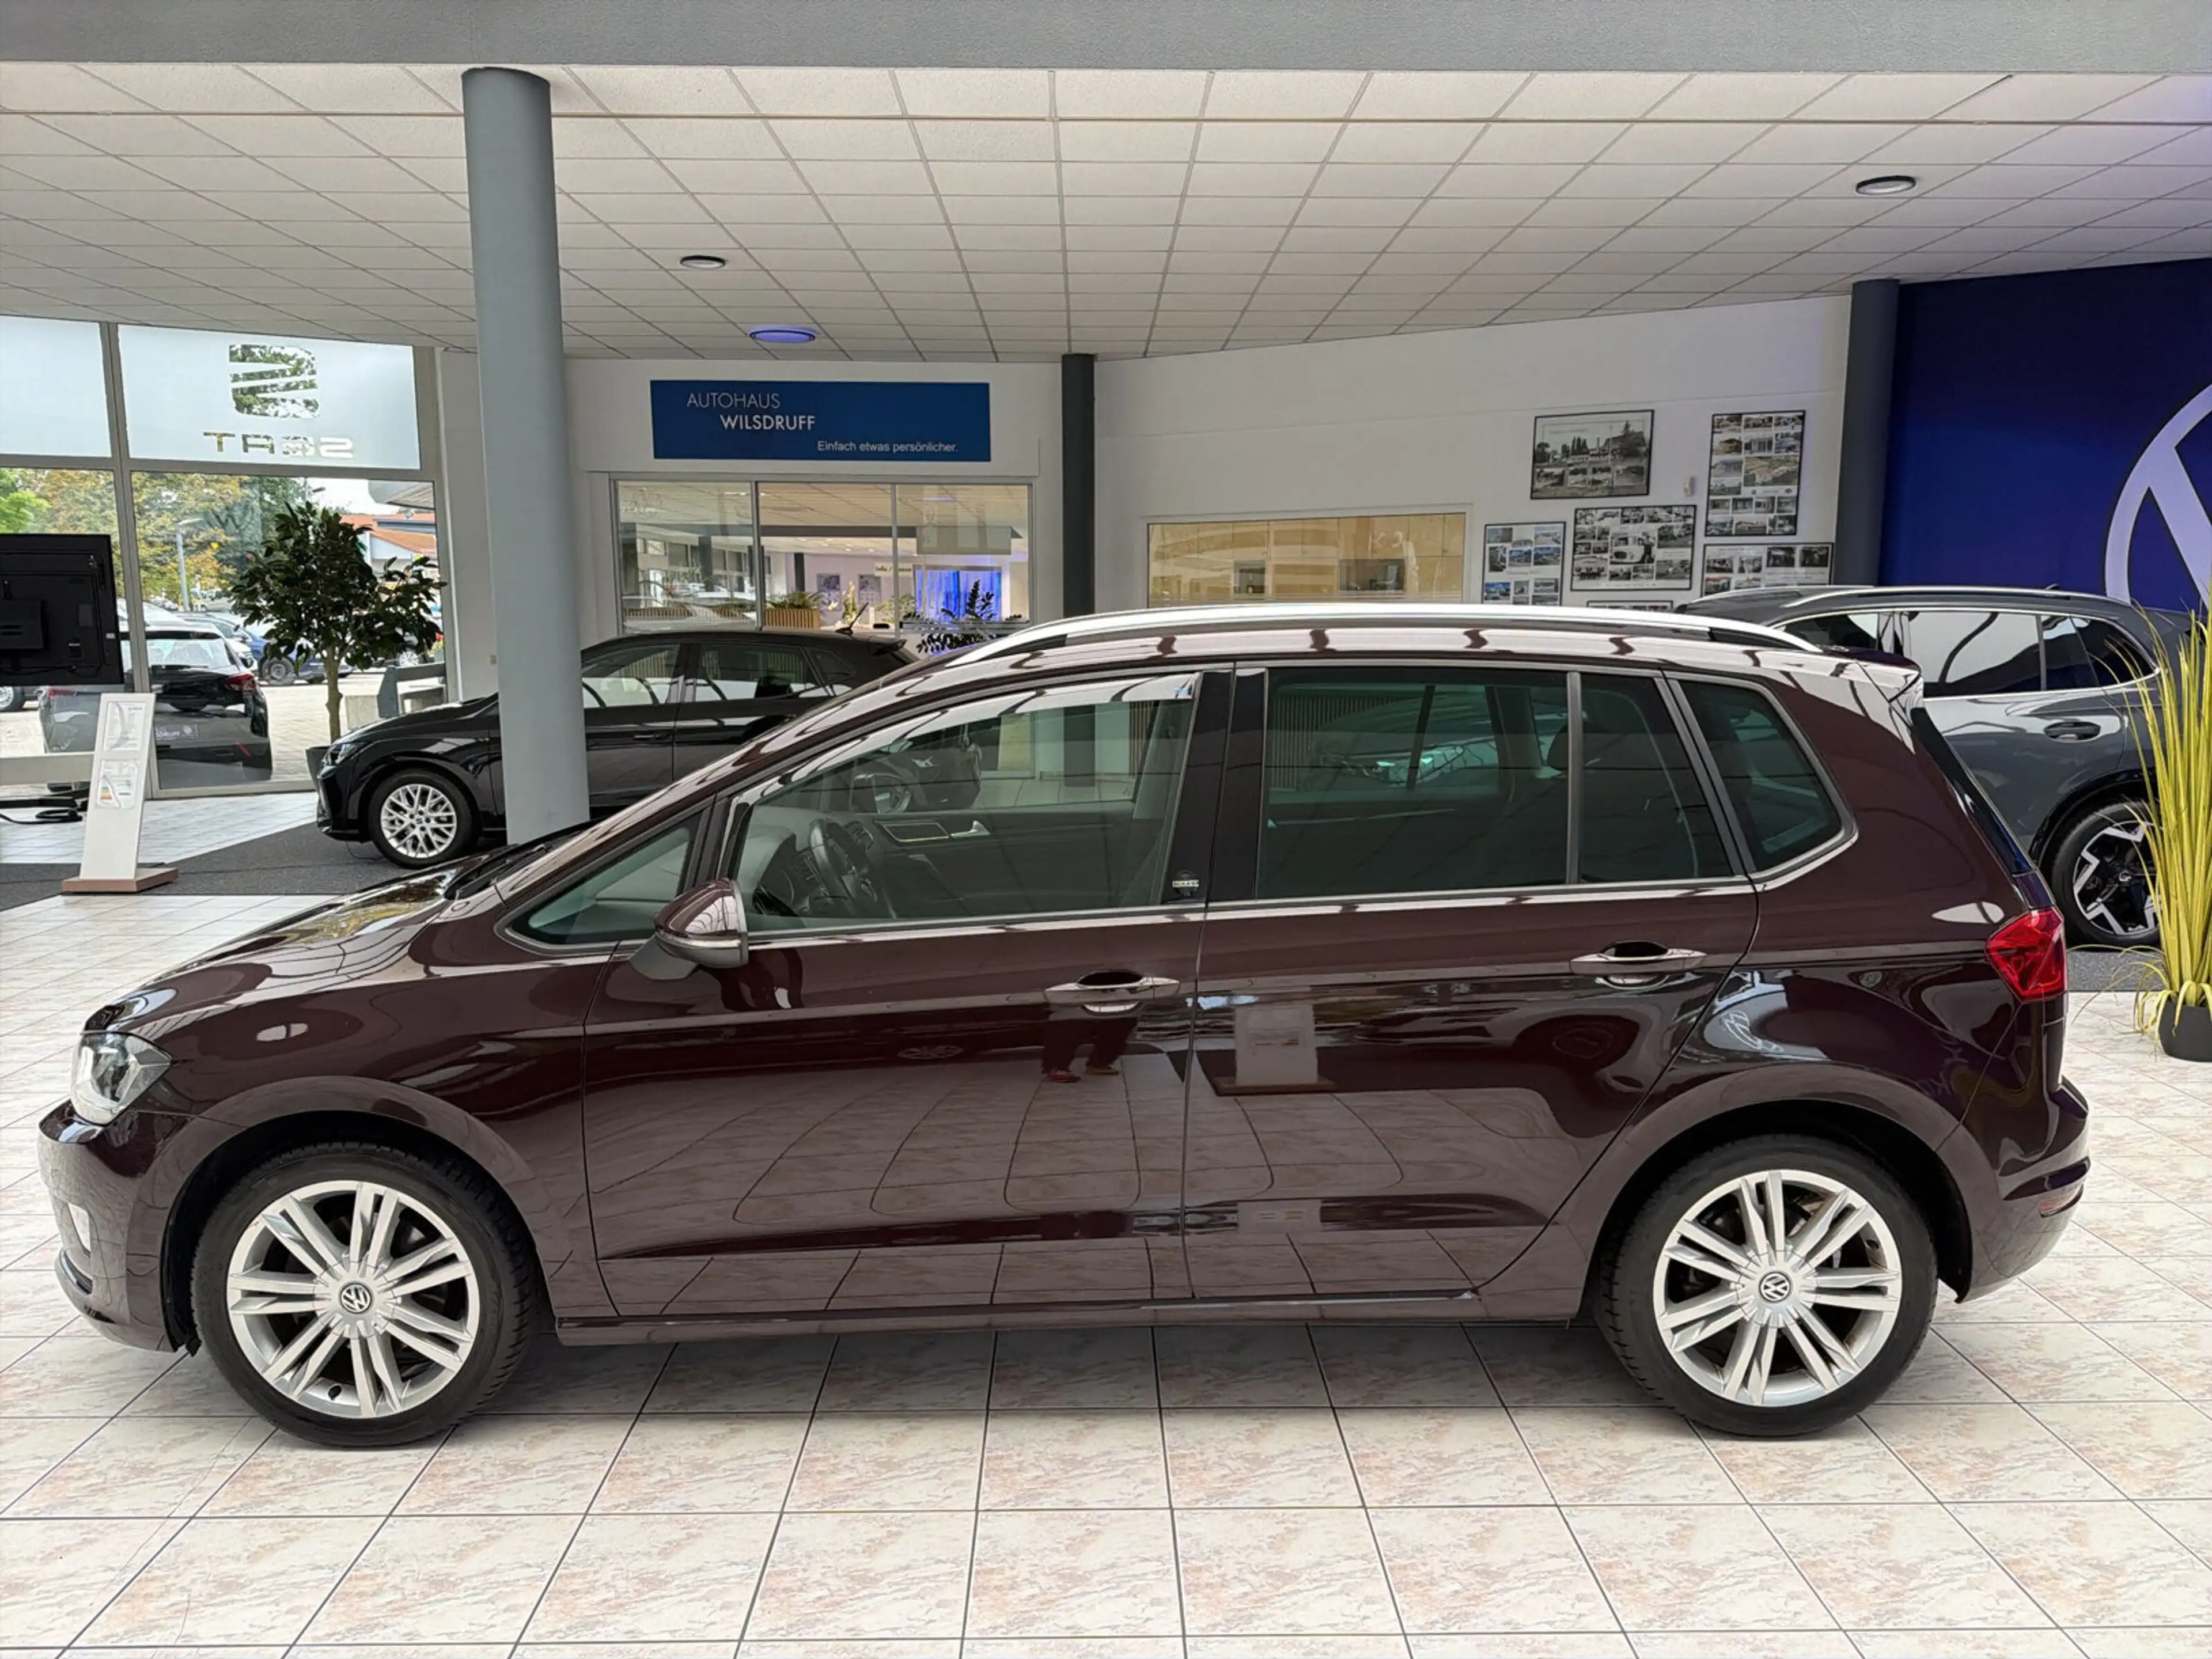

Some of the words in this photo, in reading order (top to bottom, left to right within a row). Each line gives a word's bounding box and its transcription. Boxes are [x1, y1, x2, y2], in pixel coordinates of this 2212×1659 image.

[687, 392, 781, 408] AUTOHAUS
[720, 414, 815, 430] WILSDRUFF
[817, 441, 856, 452] Einfach
[859, 442, 890, 452] etwas
[893, 441, 958, 453] persönlicher.
